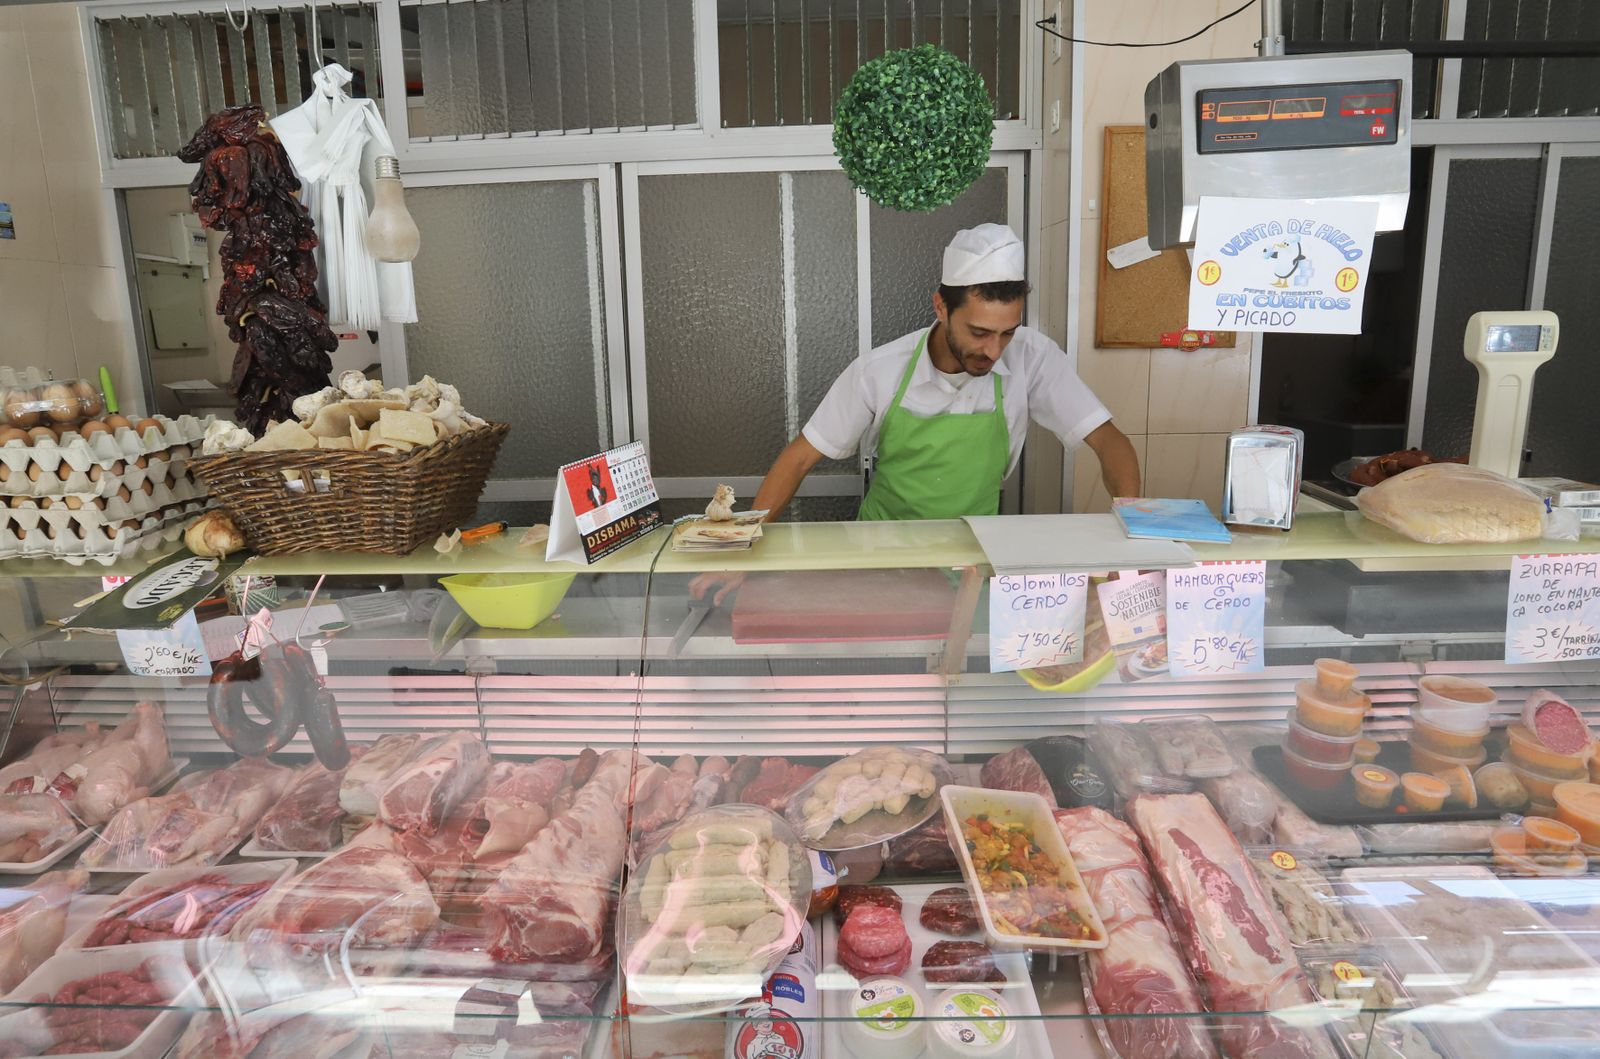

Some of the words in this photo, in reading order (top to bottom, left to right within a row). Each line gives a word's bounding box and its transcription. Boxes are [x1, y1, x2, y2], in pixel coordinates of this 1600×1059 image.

[1372, 126, 1385, 135] FW
[1220, 221, 1282, 256] VENTA
[1287, 219, 1315, 235] DE
[1314, 224, 1363, 261] HIELO
[1216, 294, 1247, 307] EN
[1253, 295, 1351, 310] CUBITOS
[1217, 309, 1227, 326] Y
[1234, 309, 1296, 327] PICADO
[587, 516, 637, 548] DISBAMA
[1519, 562, 1597, 579] ZURRAPA
[999, 573, 1086, 593] Solomillos
[1543, 579, 1560, 589] DE
[1012, 594, 1068, 611] CERDO
[1109, 587, 1161, 617] SOSTENIBLE
[1122, 598, 1161, 621] NATURAL
[1175, 602, 1189, 610] DE
[1204, 597, 1251, 610] CERDO
[1561, 648, 1582, 658] 500
